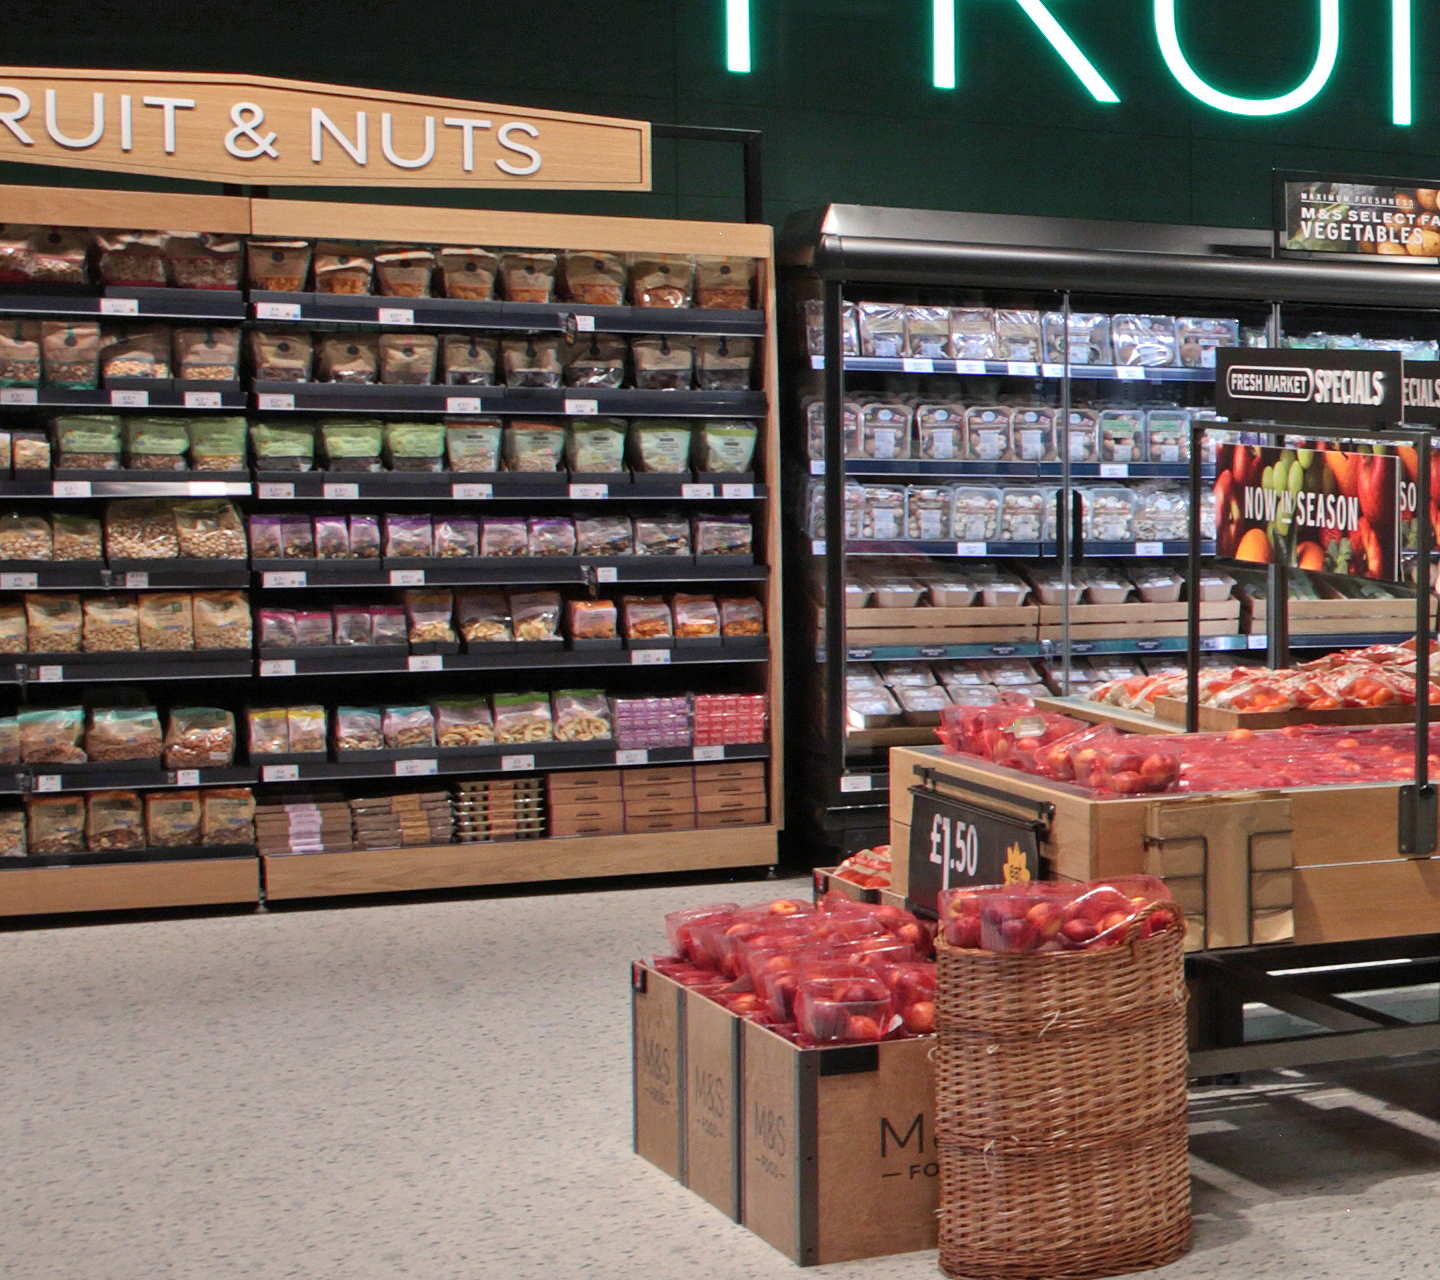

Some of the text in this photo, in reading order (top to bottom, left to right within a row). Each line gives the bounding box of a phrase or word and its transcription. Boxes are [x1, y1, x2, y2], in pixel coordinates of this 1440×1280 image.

[223, 101, 280, 160] &
[310, 107, 543, 177] NUTS
[1301, 206, 1343, 221] M&S
[1348, 210, 1416, 225] SELECT
[1301, 220, 1424, 246] VEGETABLES
[1231, 368, 1385, 406] FRESH MARKET SPECIALS
[1244, 485, 1277, 521] NOW
[1281, 490, 1292, 515] IN
[1296, 490, 1359, 532] SEASON
[929, 813, 978, 891] £1.50
[753, 1101, 786, 1158] M&S
